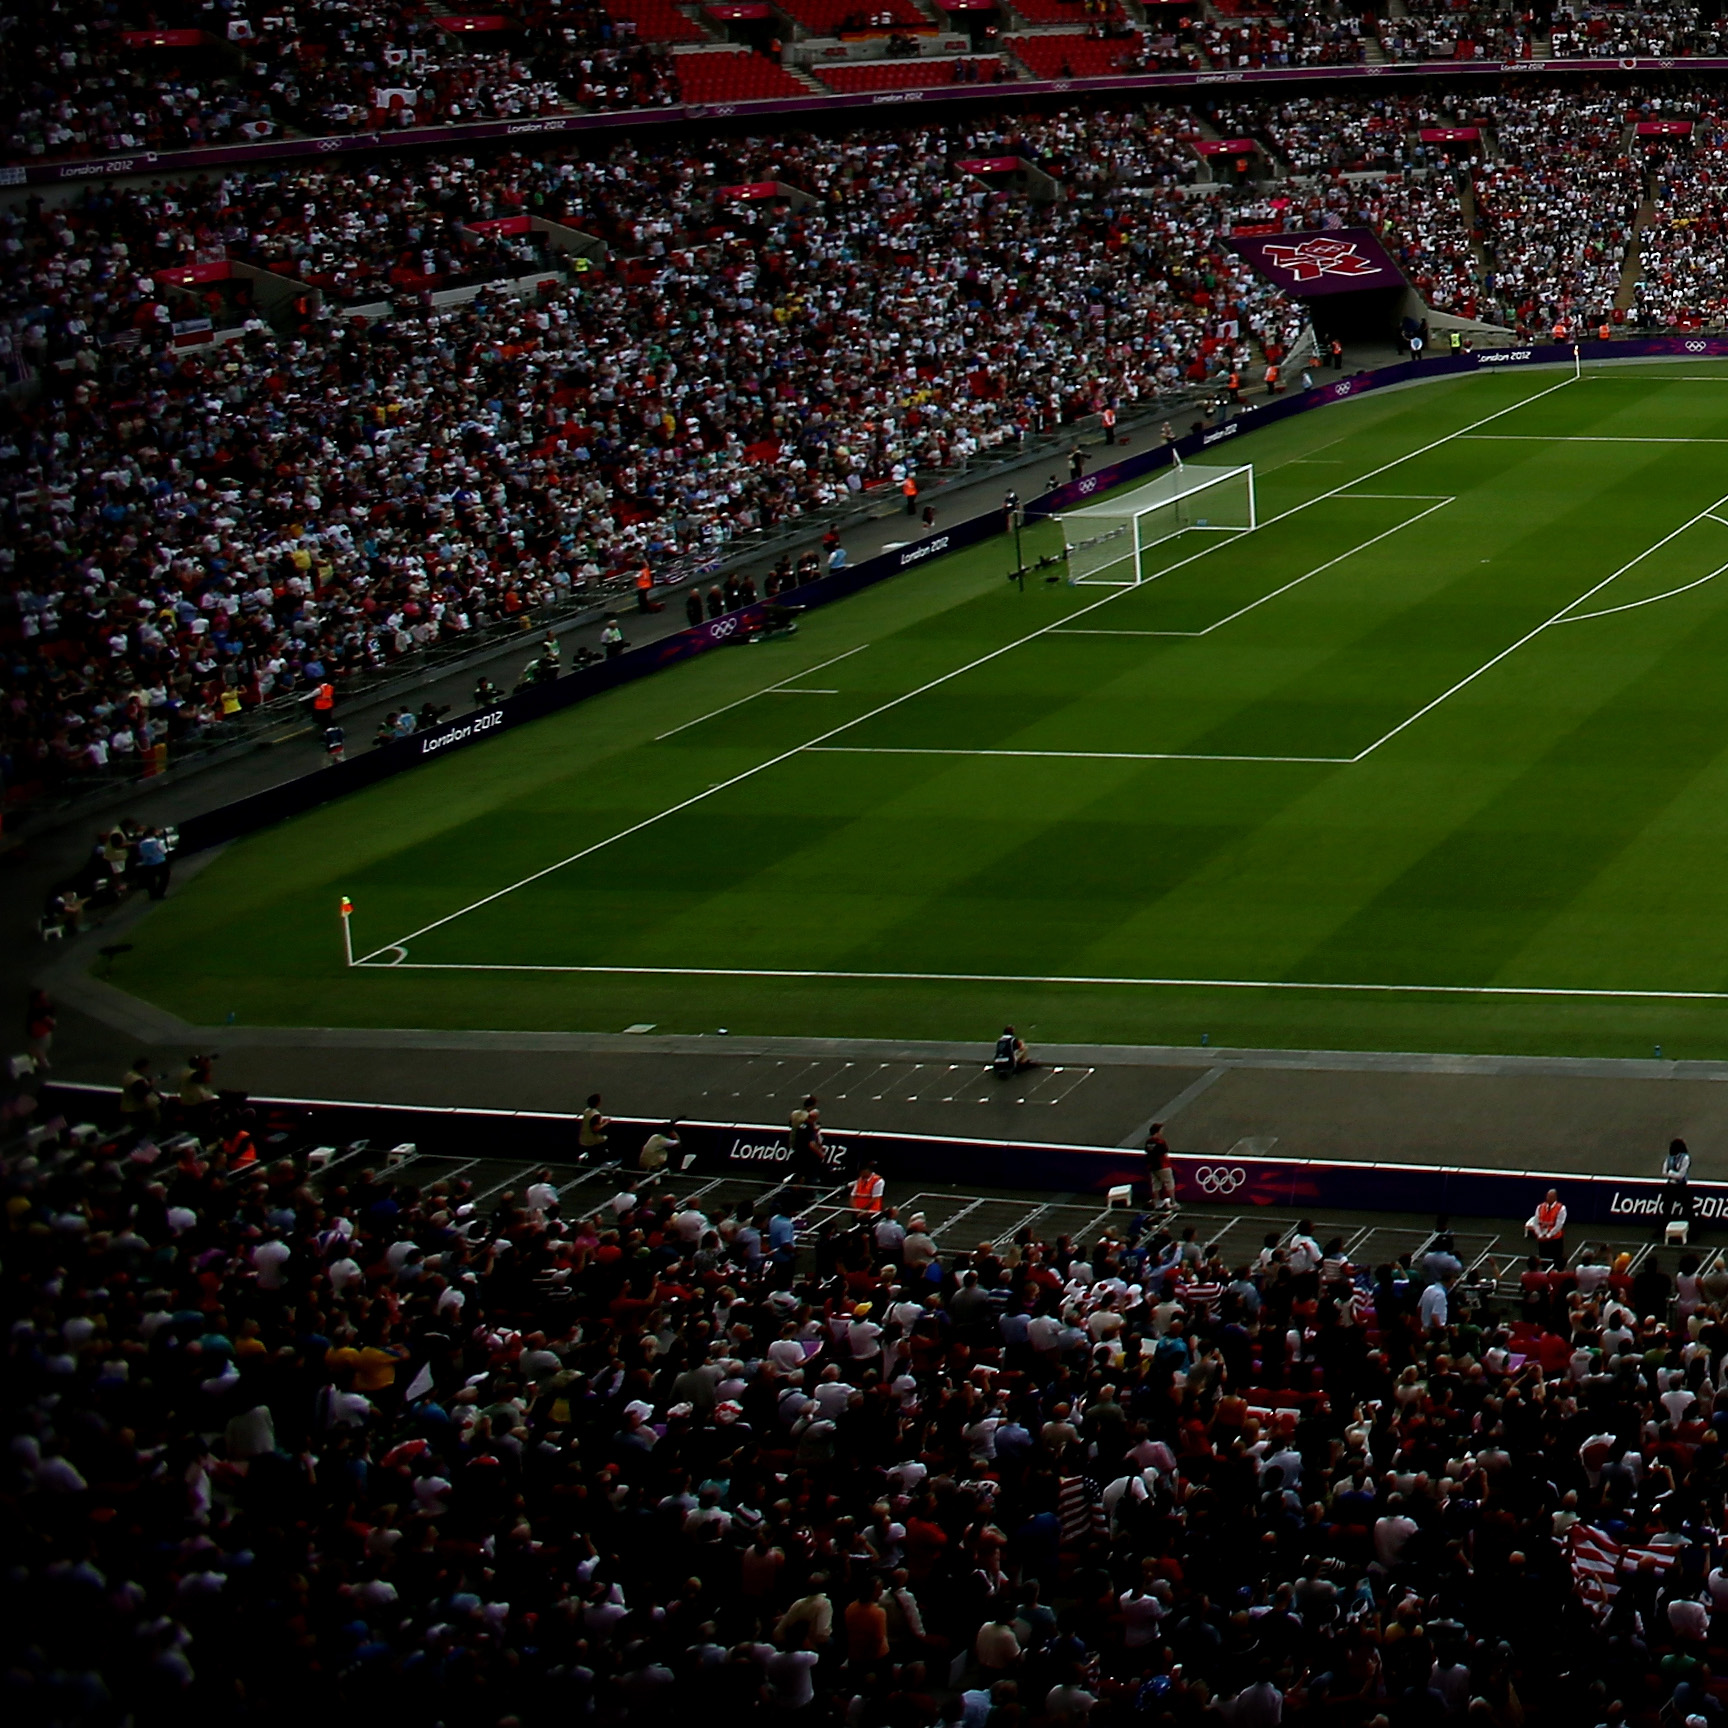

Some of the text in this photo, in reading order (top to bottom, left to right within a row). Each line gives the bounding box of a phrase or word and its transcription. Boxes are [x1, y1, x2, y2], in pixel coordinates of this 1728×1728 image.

[873, 92, 903, 103] London
[508, 123, 542, 133] London
[61, 164, 104, 177] London
[900, 546, 930, 565] London
[422, 710, 503, 754] London 2012
